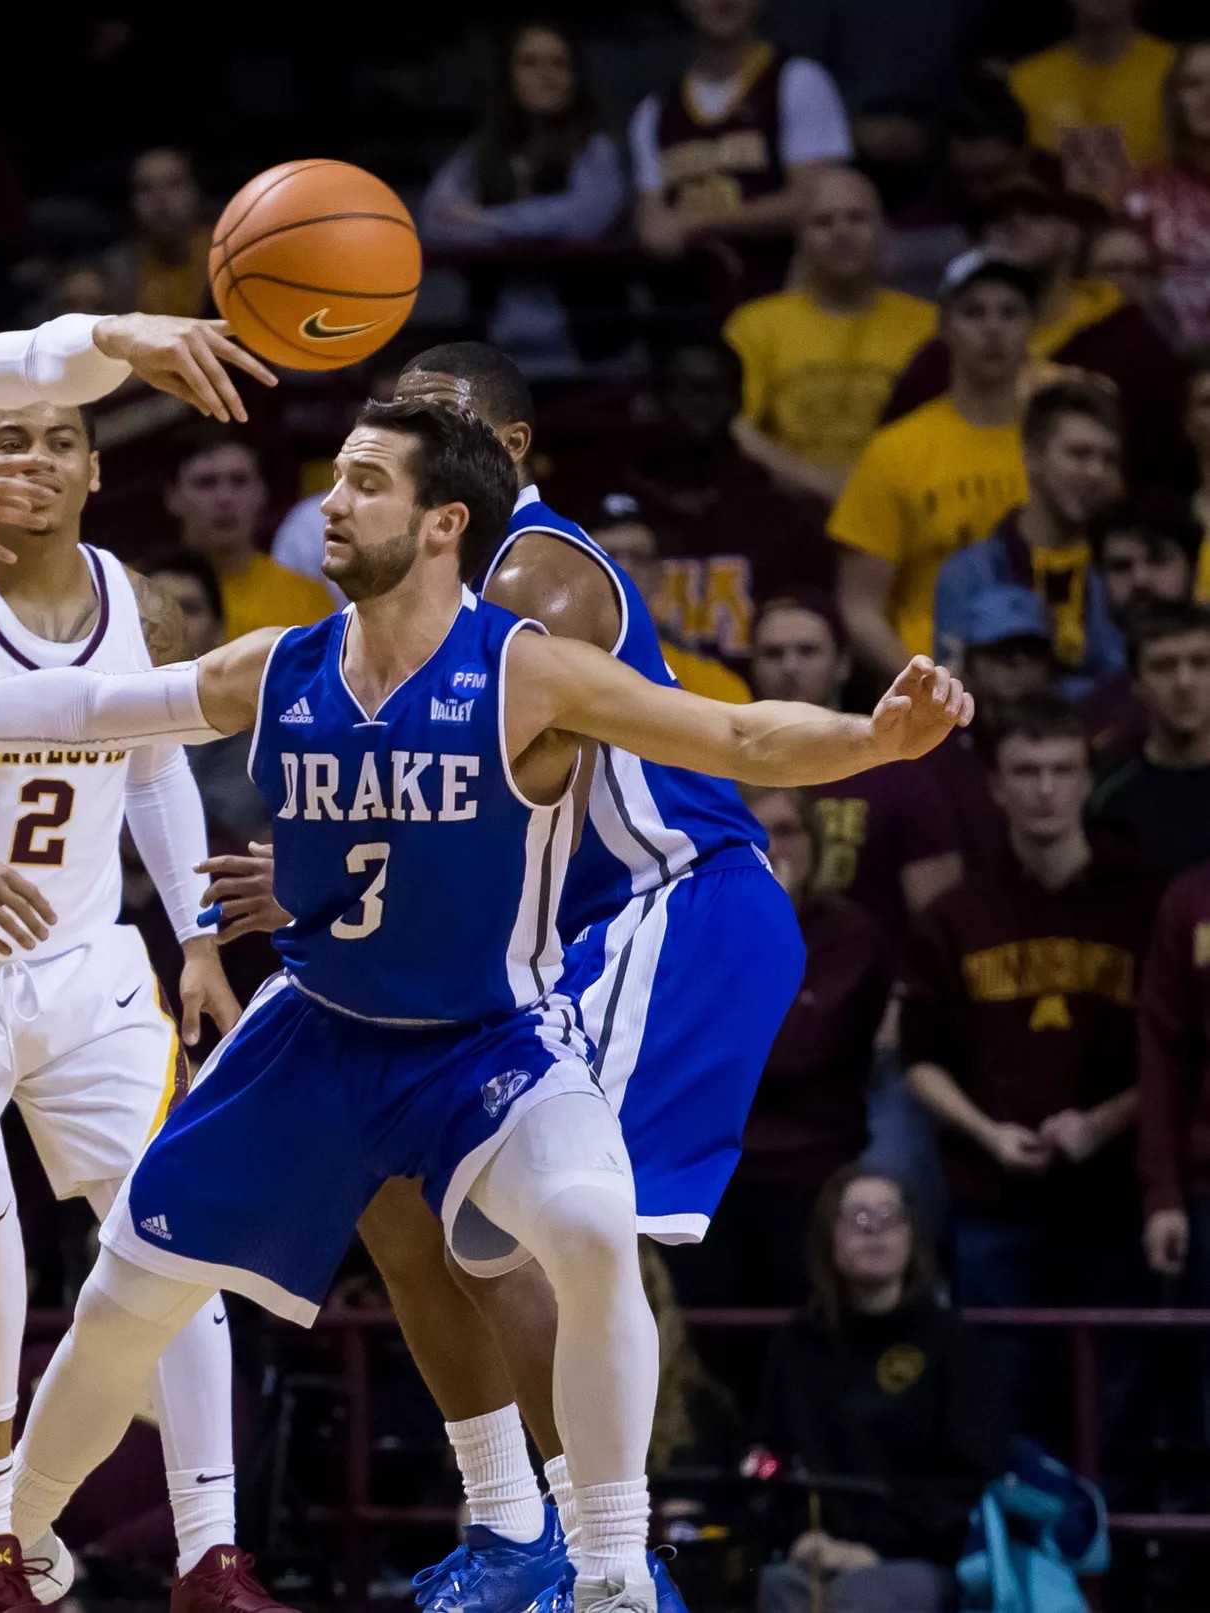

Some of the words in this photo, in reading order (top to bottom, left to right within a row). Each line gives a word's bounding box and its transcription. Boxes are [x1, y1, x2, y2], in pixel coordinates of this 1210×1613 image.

[452, 672, 487, 688] PFM
[279, 713, 314, 724] adidas
[431, 696, 475, 722] VALLEY
[277, 750, 480, 822] DRAKE
[8, 778, 75, 867] 2
[330, 841, 390, 940] 3
[140, 1219, 173, 1241] adidas
